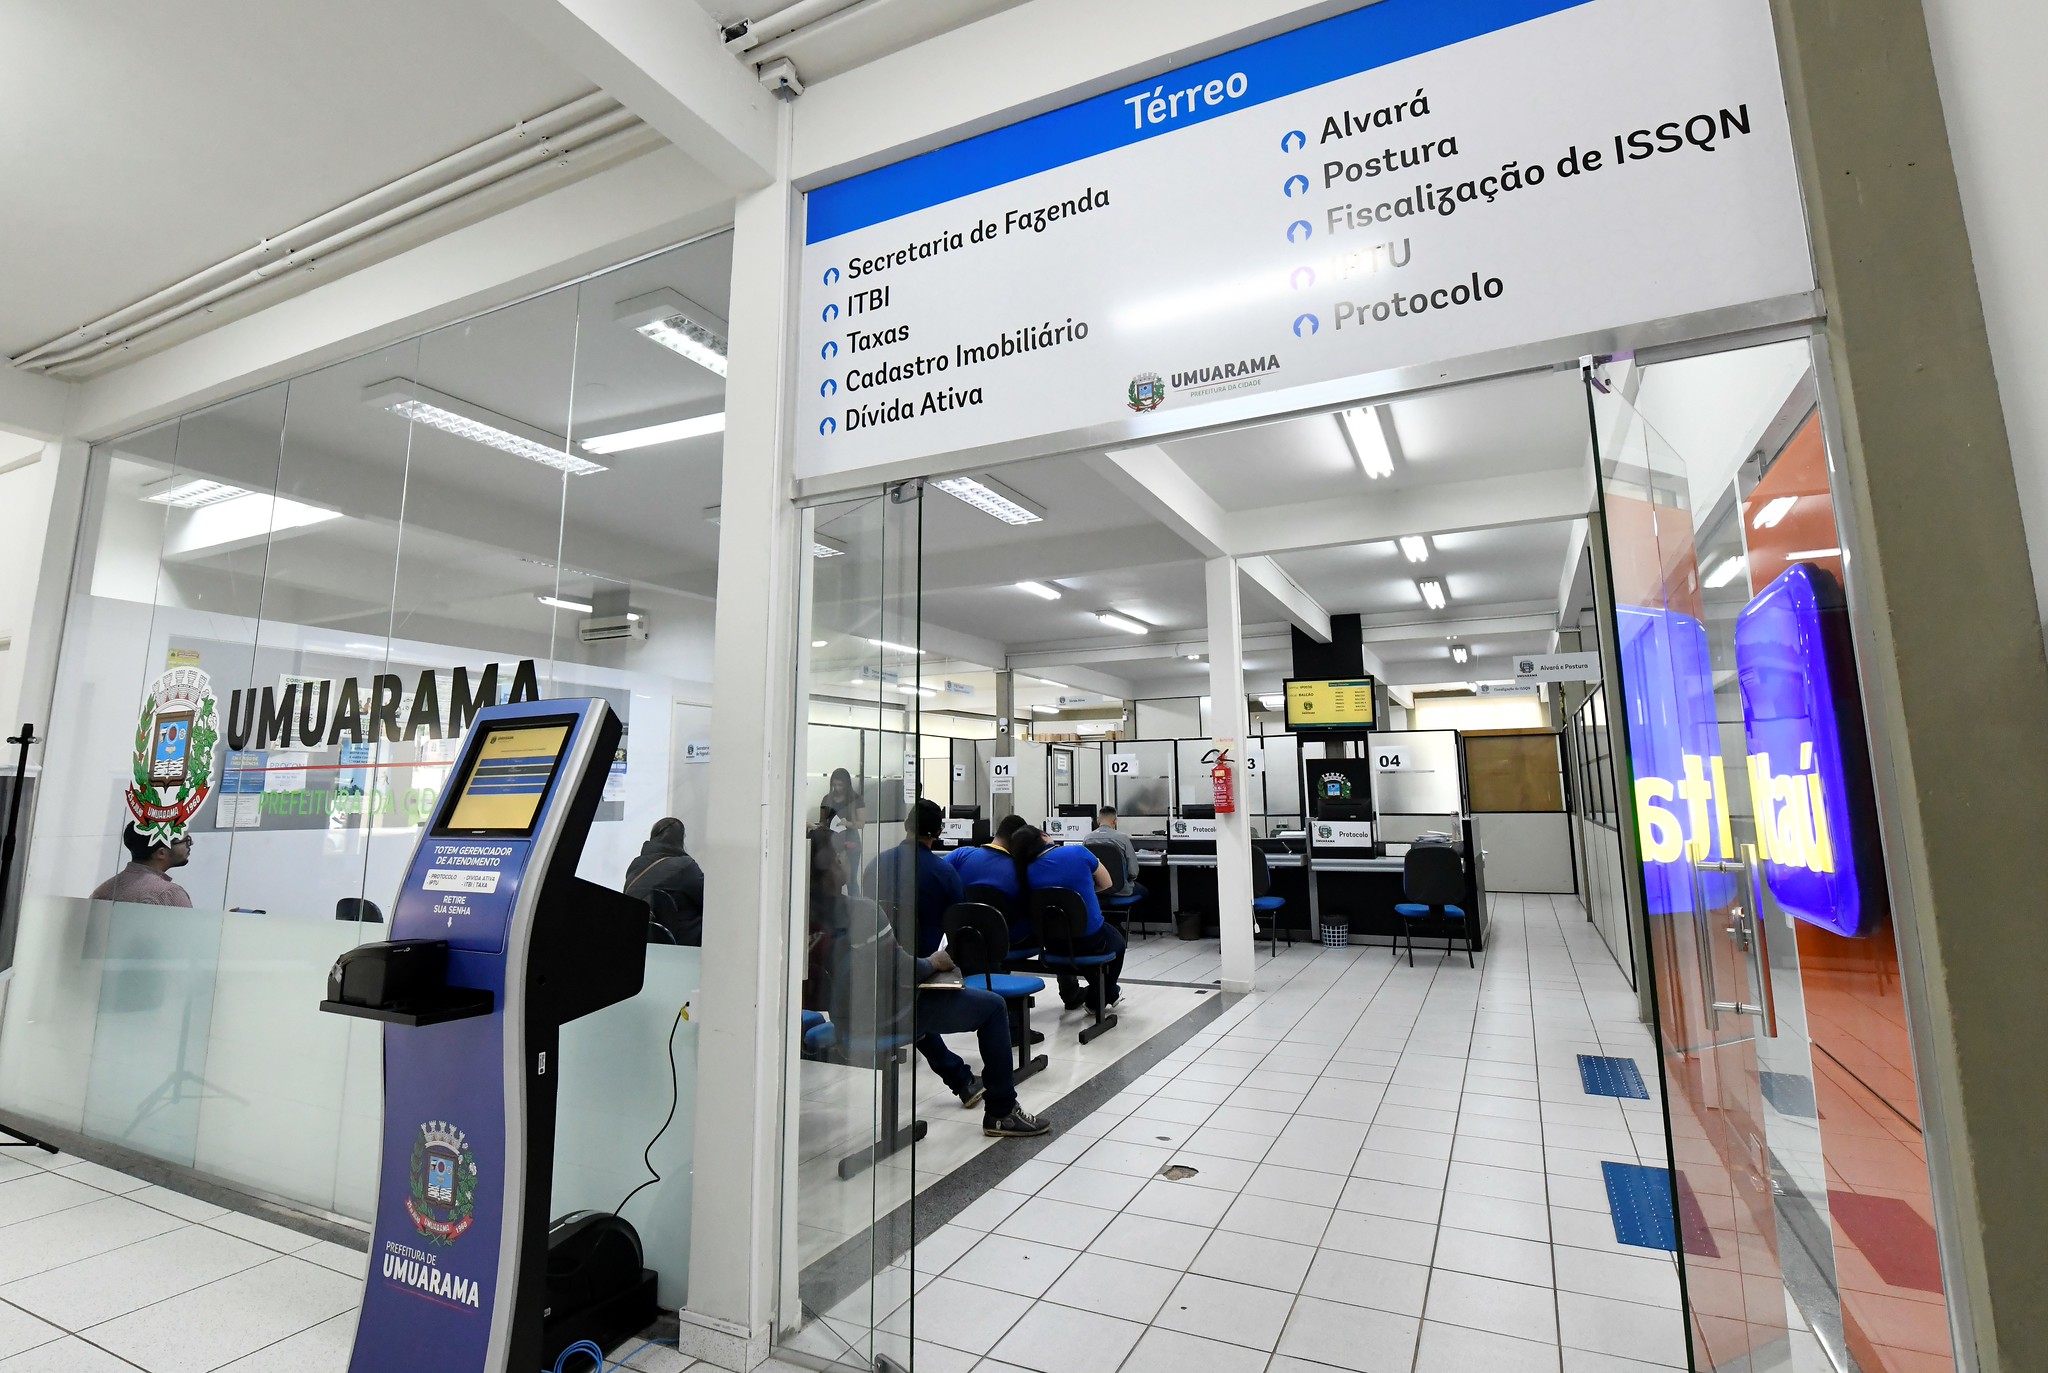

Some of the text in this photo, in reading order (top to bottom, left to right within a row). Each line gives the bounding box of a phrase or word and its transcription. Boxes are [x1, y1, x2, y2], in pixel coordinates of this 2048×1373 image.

[1125, 71, 1248, 129] Térreo
[1320, 88, 1430, 144] Alvará
[1324, 136, 1459, 189] Postura
[1327, 104, 1752, 234] Fiscalização de ISSQN
[847, 187, 1110, 279] Secretaria de Fazenda
[847, 286, 891, 317] ITBI
[1335, 271, 1504, 330] Protocolo
[847, 324, 910, 354] Taxas
[845, 317, 1089, 392] Cadastro Imobiliário
[1171, 354, 1281, 388] UMUARAMA
[1190, 379, 1261, 398] PREFEITURA DA CIDADE
[845, 386, 983, 432] Dívida Ativa
[227, 659, 541, 751] UMUARAMA
[994, 764, 1009, 775] 01
[1111, 762, 1129, 773] 02
[1247, 758, 1256, 770] 3
[1379, 754, 1401, 767] 04
[148, 807, 179, 819] UMUARAMA
[186, 795, 201, 814] 1960
[258, 789, 362, 815] PREFEITURA
[373, 788, 395, 814] DA
[402, 787, 436, 815] CID
[1747, 742, 1834, 874] Itaú
[1067, 824, 1080, 832] IPTU
[1192, 825, 1217, 833] Protocol
[1339, 830, 1369, 838] Protocolo
[434, 846, 513, 856] TOTEM GERENCIADOR
[436, 856, 500, 866] DE ATENDIMENTO
[434, 905, 470, 915] SUA SENHA
[443, 896, 466, 904] RETIRE
[456, 1221, 468, 1234] 1960
[386, 1240, 437, 1266] PREFEITURA DE
[383, 1253, 479, 1308] UMUARAMA
